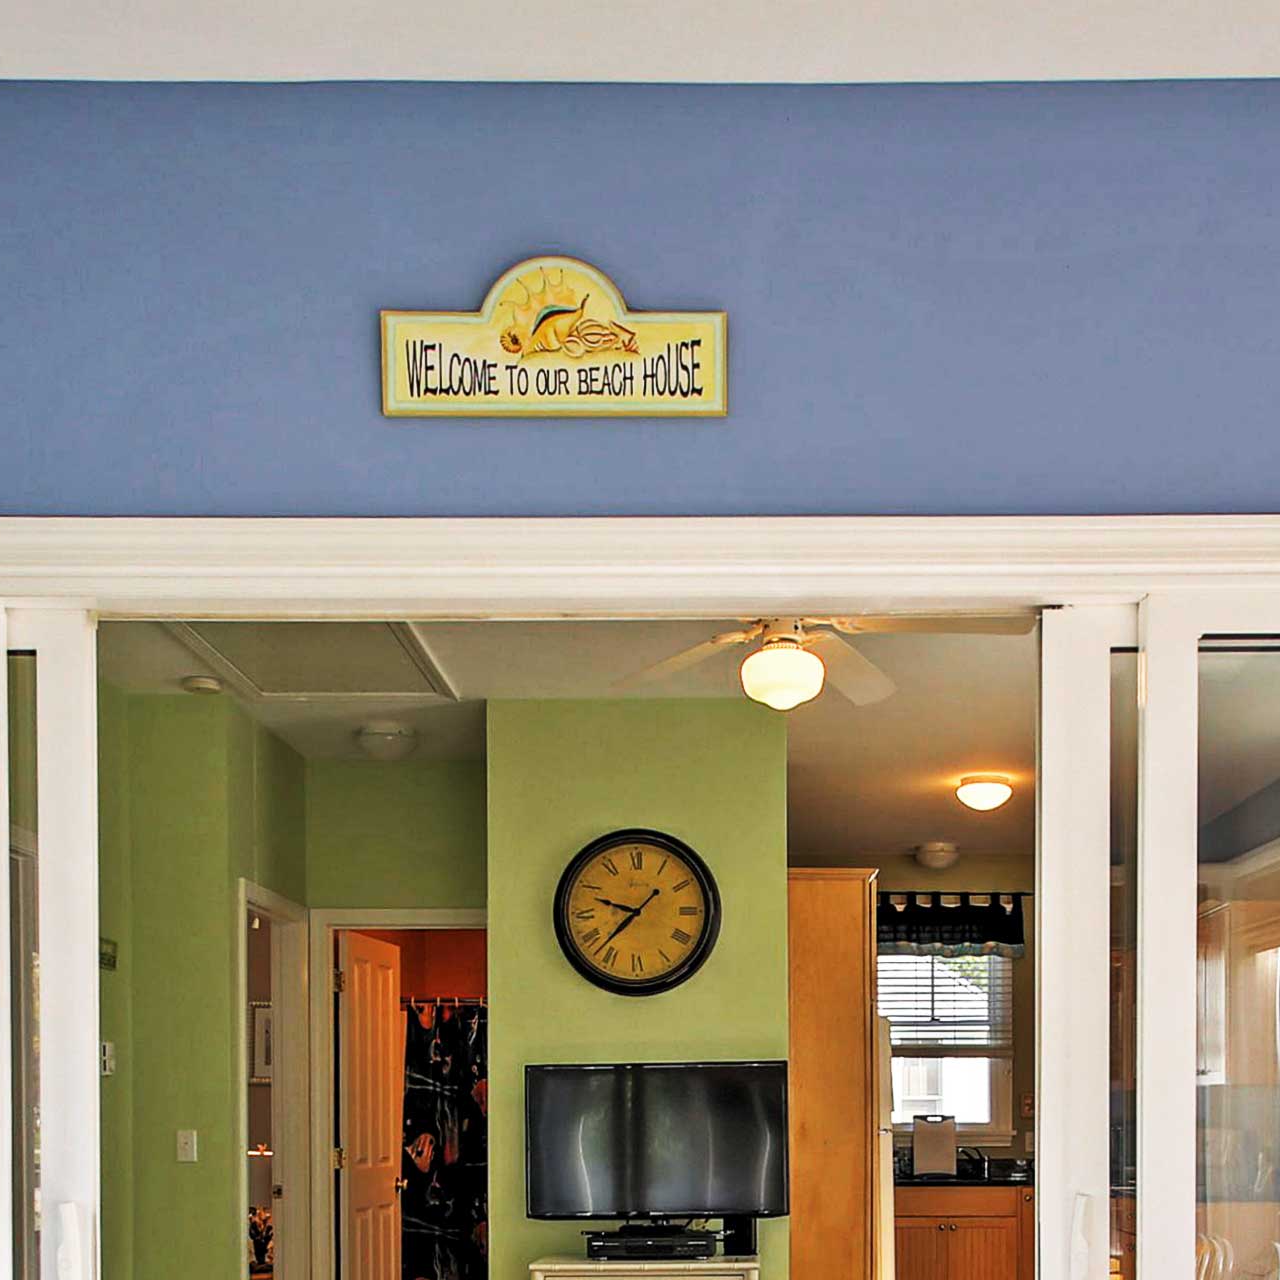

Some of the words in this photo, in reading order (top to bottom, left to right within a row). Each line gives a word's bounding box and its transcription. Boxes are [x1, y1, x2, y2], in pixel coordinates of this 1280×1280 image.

[406, 339, 500, 398] WELCOME
[505, 364, 529, 396] TO
[535, 368, 570, 396] OUR
[577, 361, 635, 397] BEACH
[643, 339, 704, 398] HOUSE
